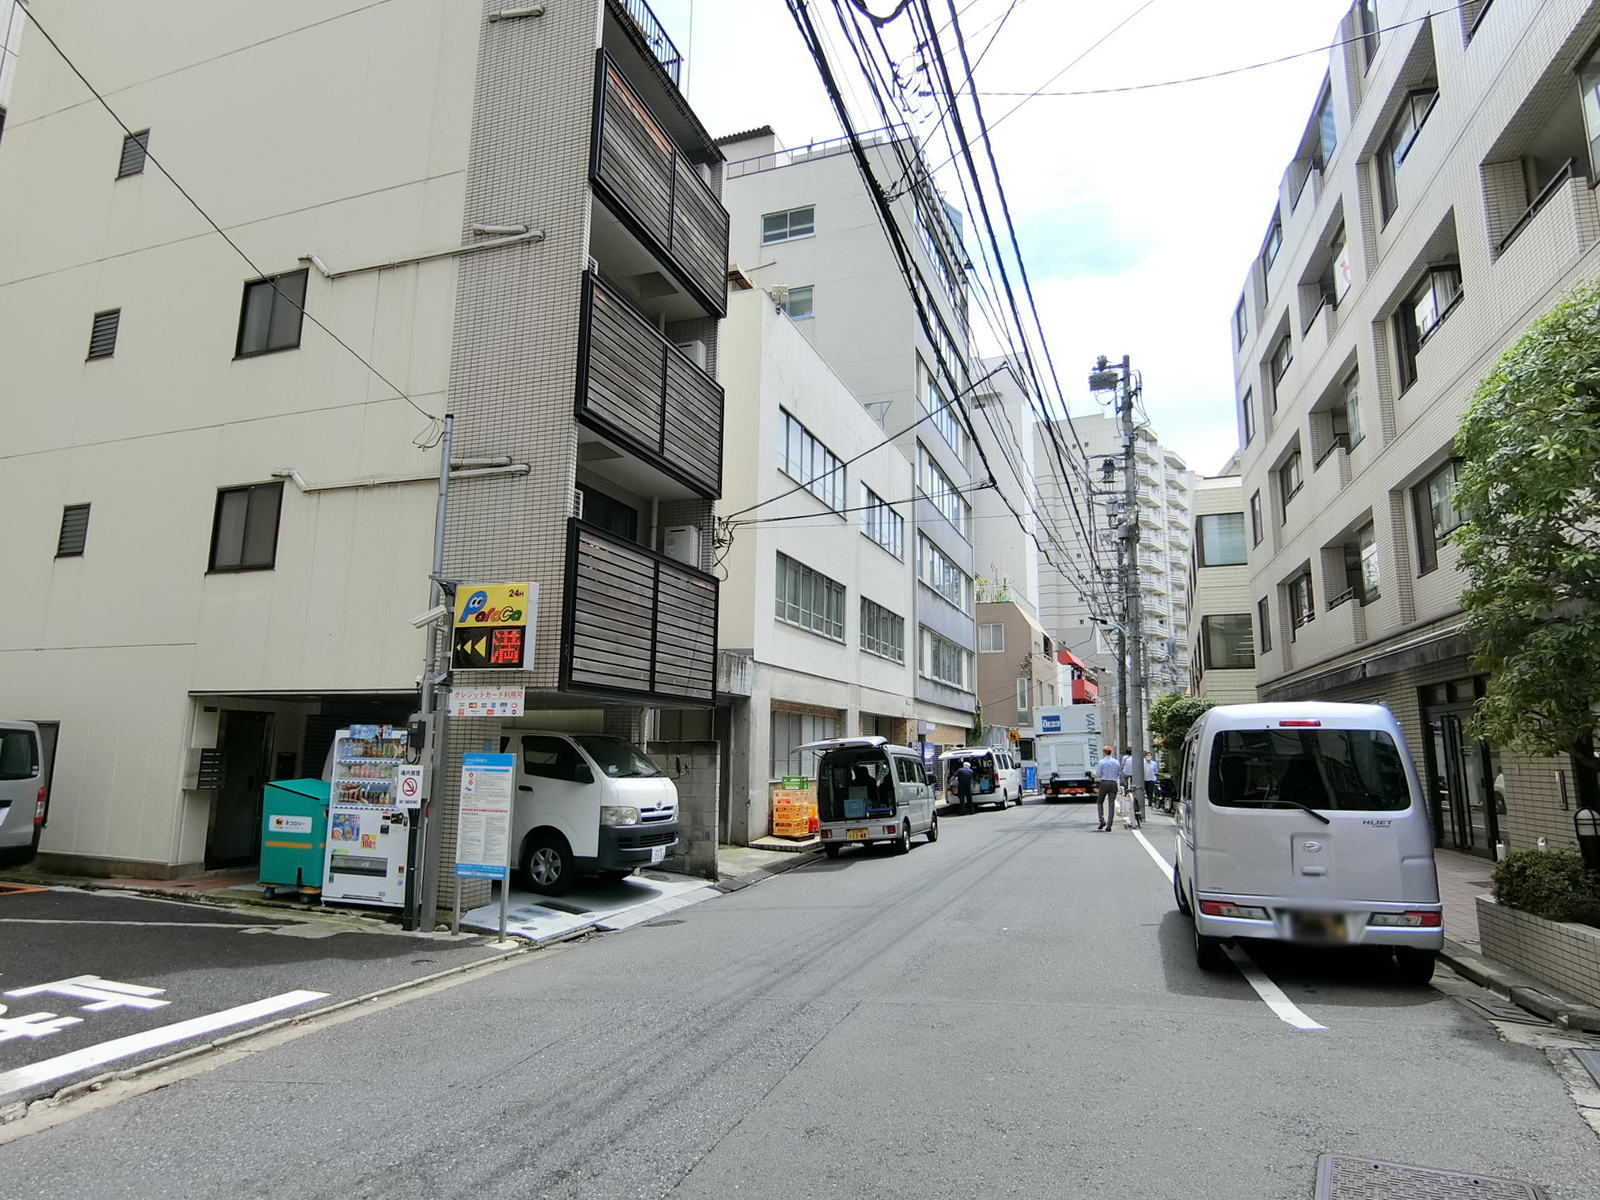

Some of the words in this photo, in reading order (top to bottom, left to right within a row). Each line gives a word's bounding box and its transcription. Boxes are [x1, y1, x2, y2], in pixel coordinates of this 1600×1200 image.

[509, 589, 524, 597] 24H
[491, 629, 521, 664] 満
[454, 691, 524, 699] クレジットカード利用可
[1085, 713, 1096, 734] VAN
[1087, 738, 1099, 767] LINES
